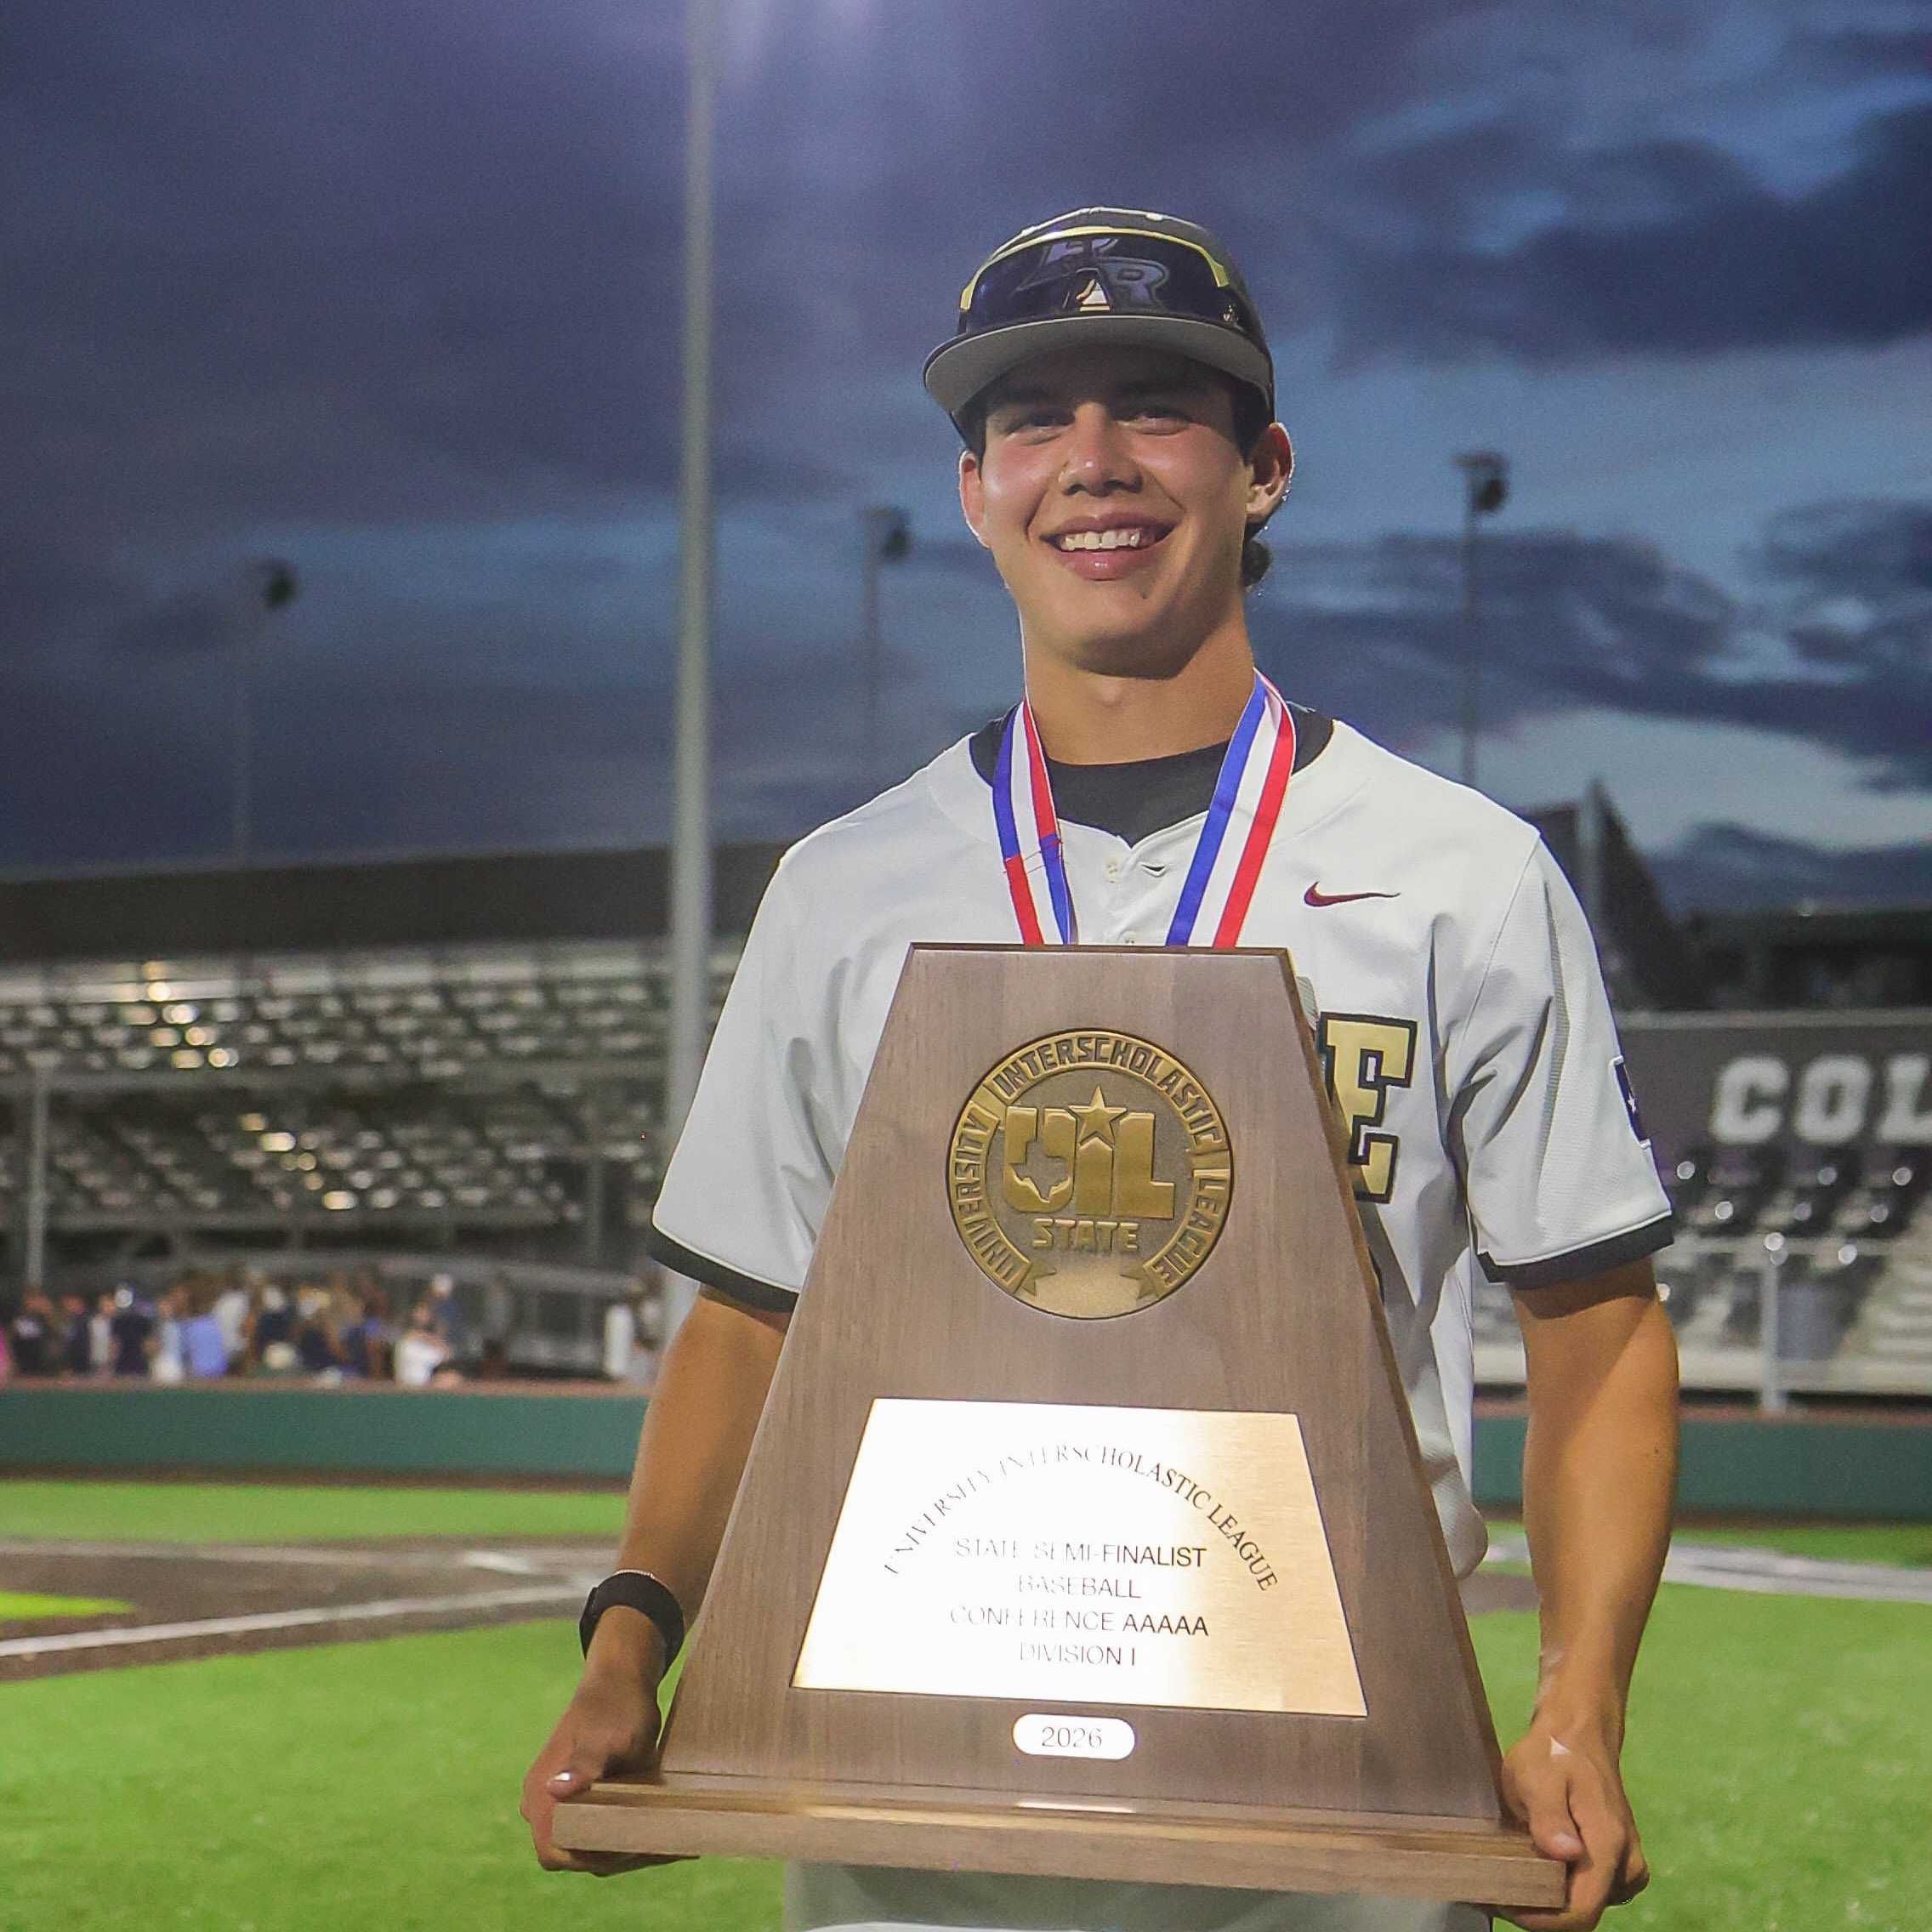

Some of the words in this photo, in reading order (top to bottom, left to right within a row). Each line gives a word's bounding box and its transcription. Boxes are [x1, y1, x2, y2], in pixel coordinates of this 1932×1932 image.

[955, 1112, 1015, 1284] UNIVERSITY
[992, 1037, 1223, 1146] INTERSCHOLASTIC
[1151, 1178, 1226, 1287] LEAGUE
[1031, 1218, 1139, 1252] STATE
[955, 1537, 1020, 1559] STATE
[1034, 1540, 1208, 1567] SEMI-FINALIST
[1206, 1503, 1279, 1591] LEAGUE
[1019, 1575, 1142, 1600] BASEBALL
[950, 1605, 1117, 1631] CONFERENCE
[1122, 1613, 1210, 1637] AAAAA
[1020, 1641, 1122, 1666] DIVISION
[1131, 1646, 1136, 1666] I
[1042, 1726, 1103, 1749] 2026
